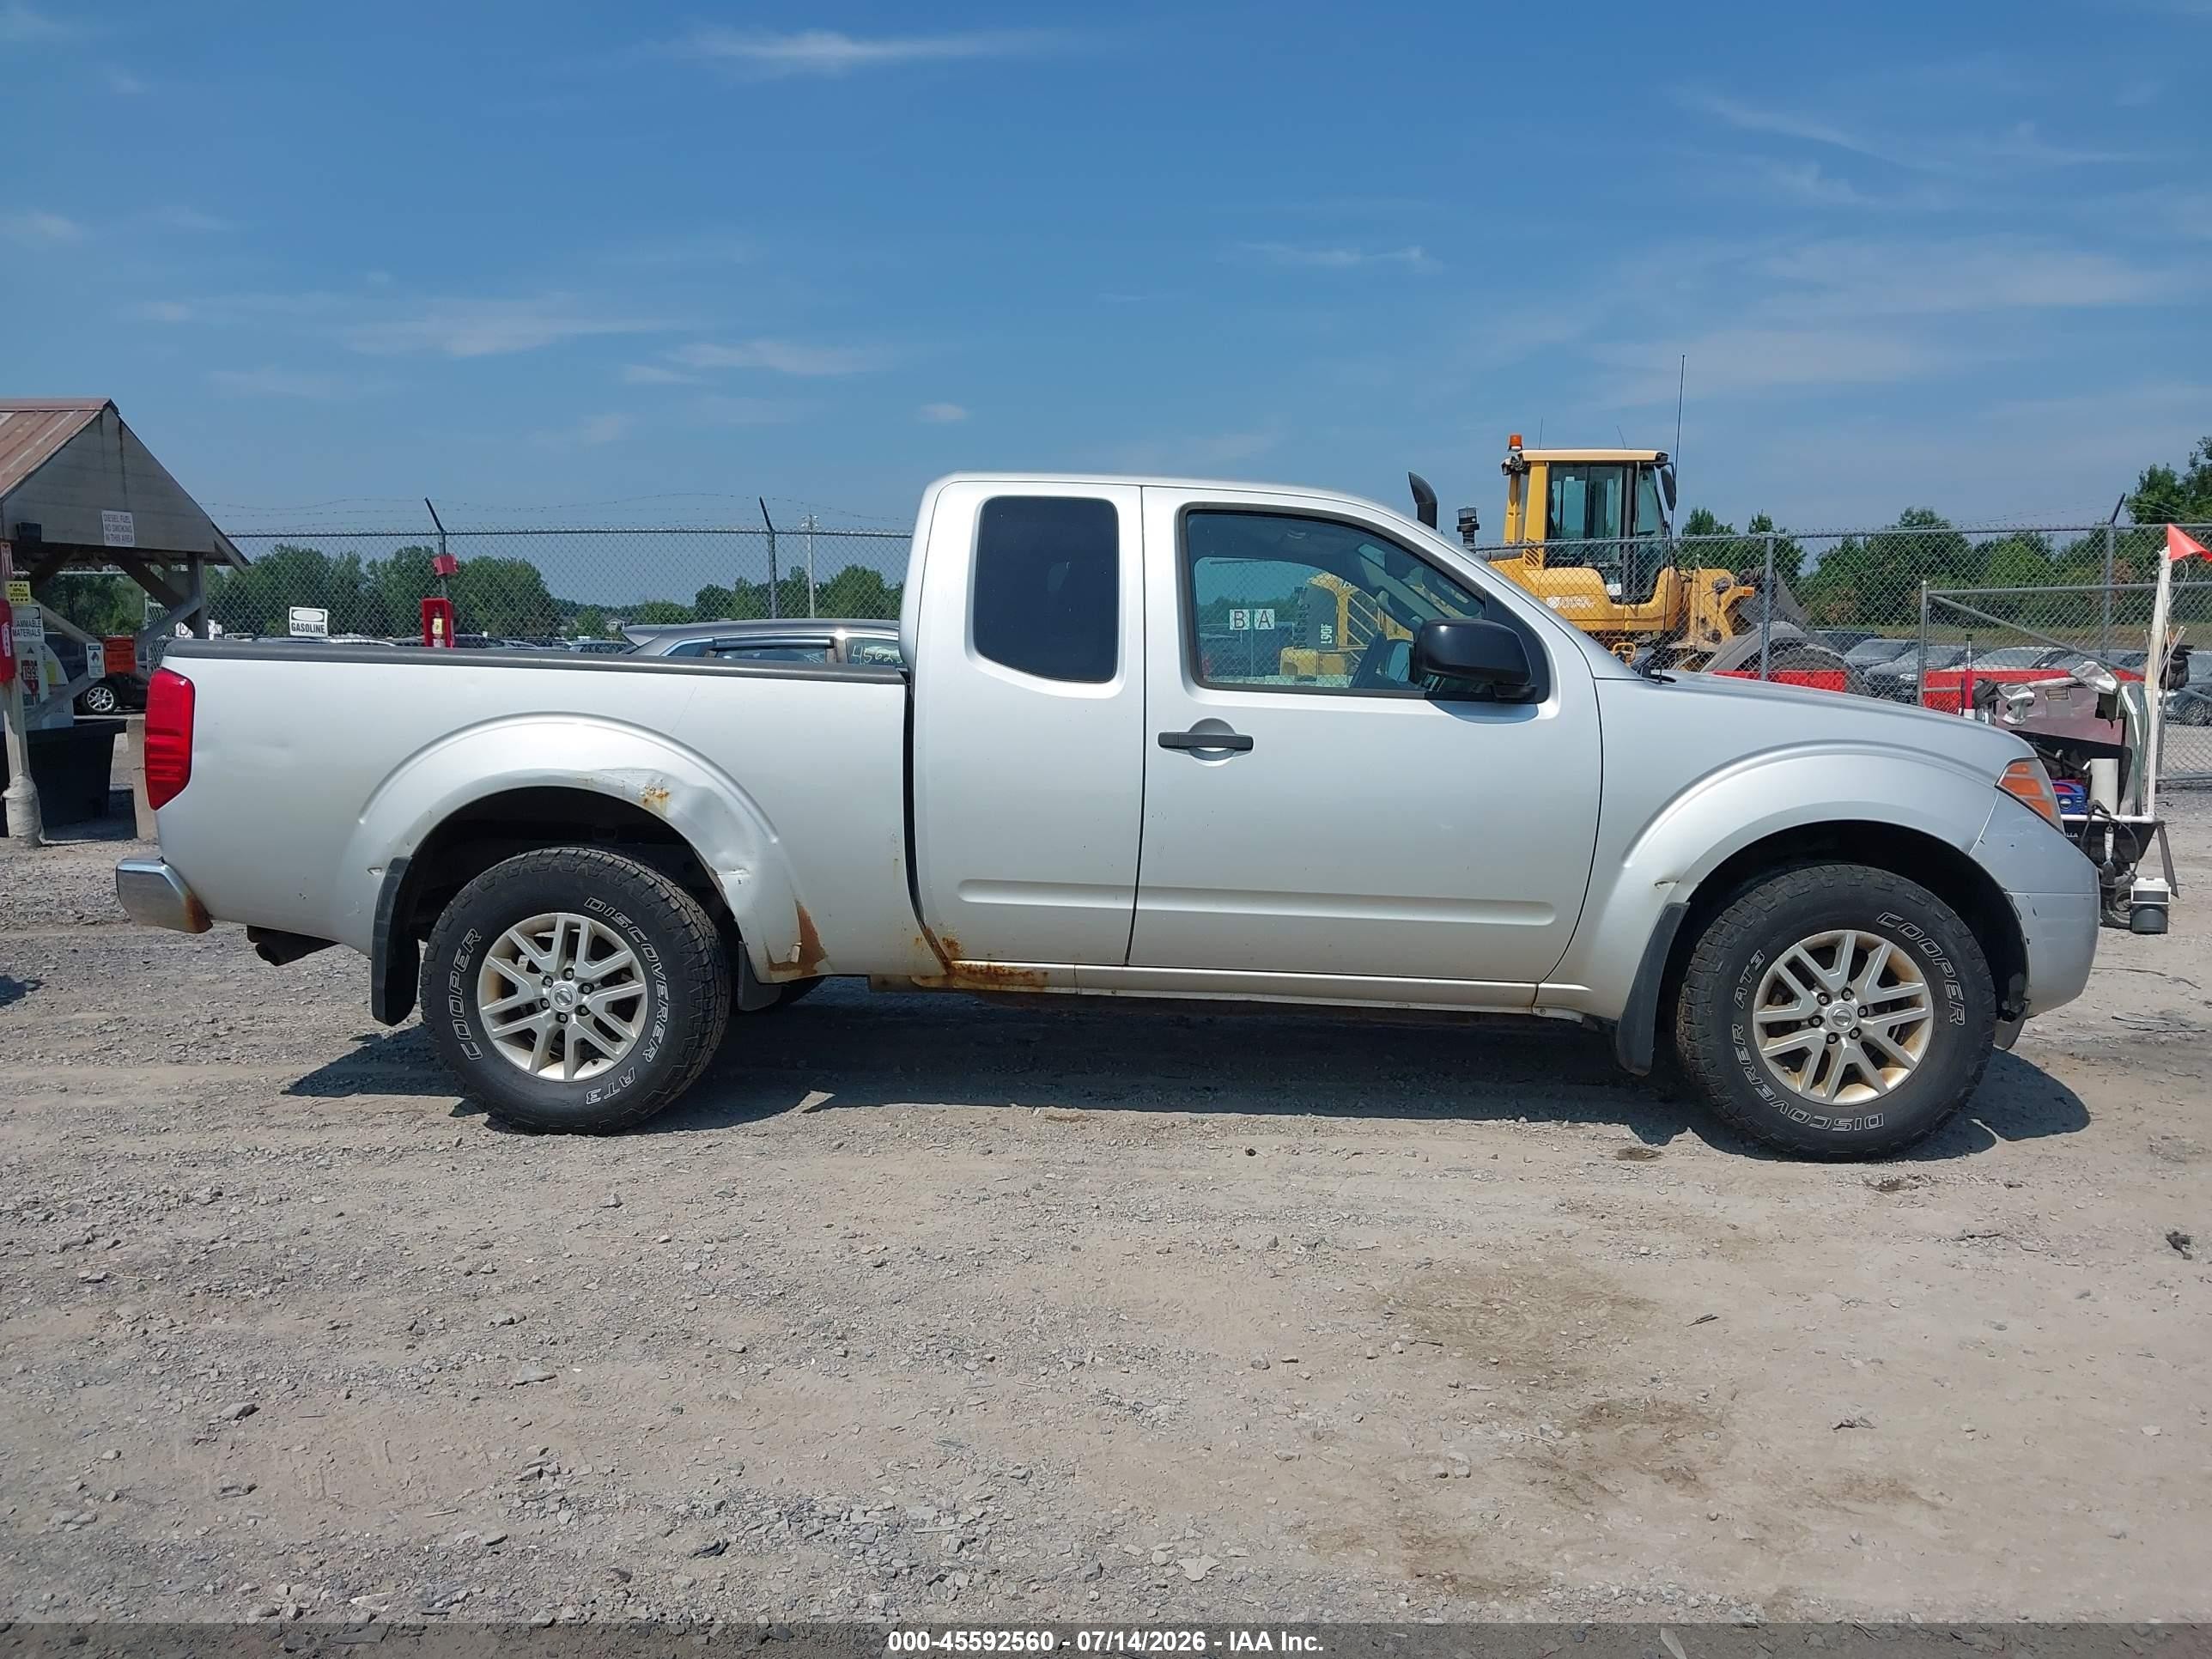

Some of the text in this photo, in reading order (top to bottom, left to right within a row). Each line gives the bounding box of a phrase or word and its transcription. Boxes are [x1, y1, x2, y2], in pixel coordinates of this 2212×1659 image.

[15, 619, 42, 629] AMMABLE
[291, 622, 325, 634] GASOLINE
[1234, 611, 1245, 629] B
[1258, 611, 1271, 629] A
[12, 628, 41, 638] MATERIALS
[1320, 623, 1333, 644] L90F
[1876, 911, 1966, 1026] COOPER
[448, 927, 483, 1060] COOPER
[583, 896, 670, 1105] DISCOVERER AT3
[1732, 949, 1884, 1132] DISCOVERER AT3
